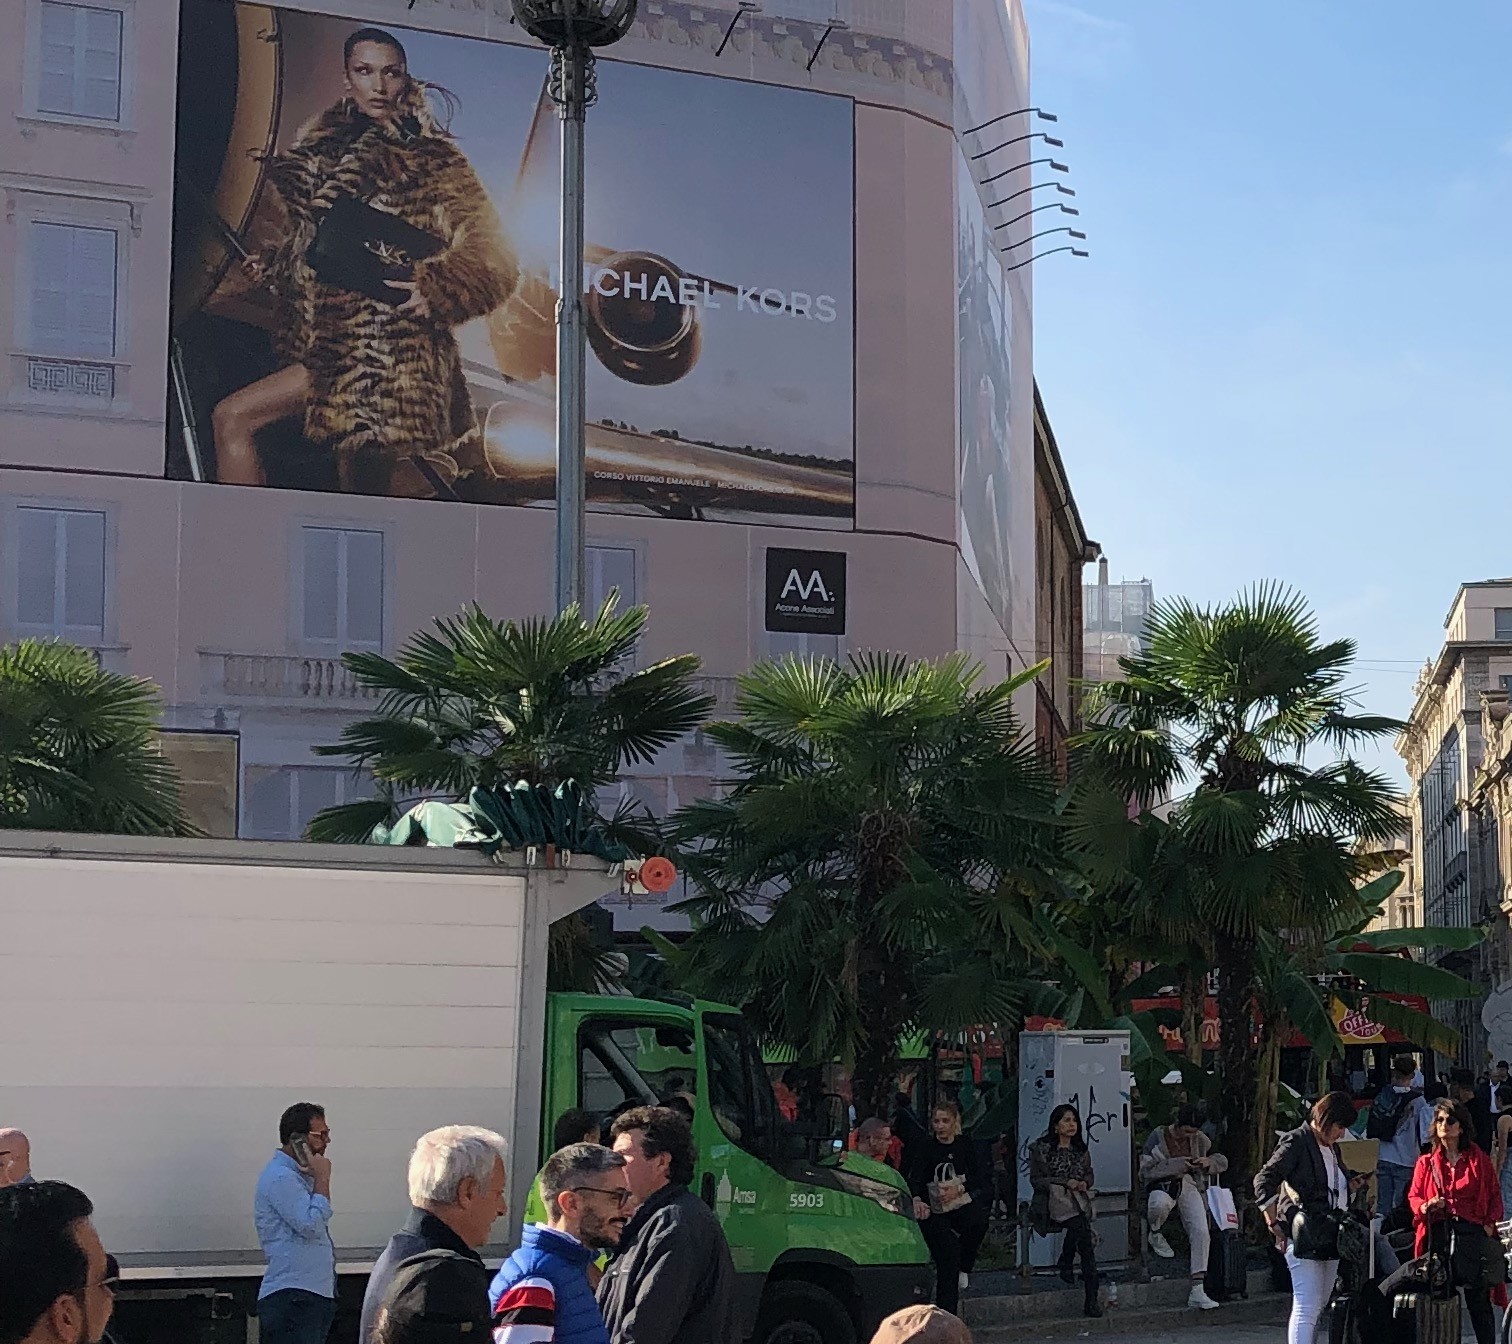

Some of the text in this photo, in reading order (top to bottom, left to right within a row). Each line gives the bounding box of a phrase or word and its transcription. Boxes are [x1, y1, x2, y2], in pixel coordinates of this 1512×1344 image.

[549, 262, 838, 323] ICHAEL KORS
[594, 470, 624, 481] CORSO
[626, 473, 664, 484] VITTORIO
[666, 476, 710, 488] EMANUELE
[789, 1193, 824, 1208] 5903
